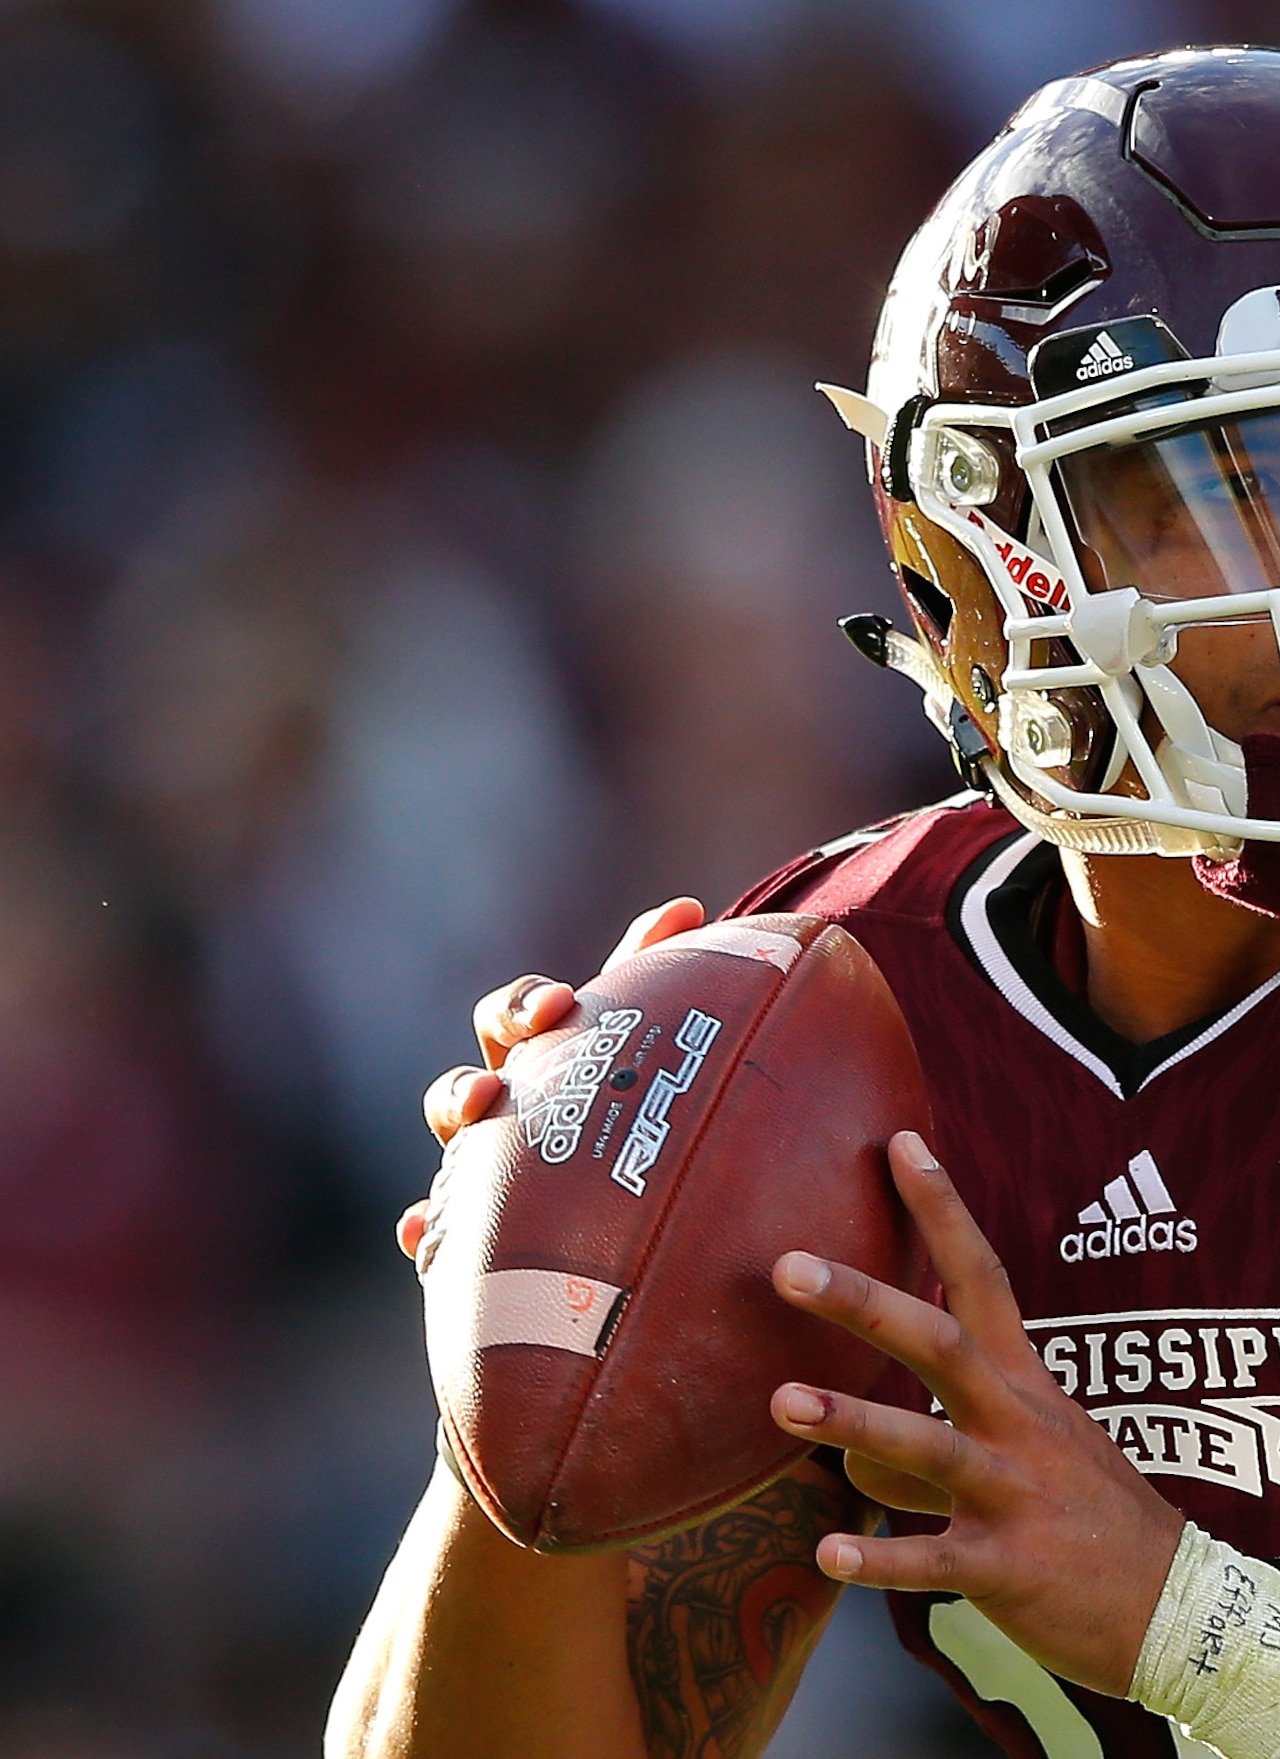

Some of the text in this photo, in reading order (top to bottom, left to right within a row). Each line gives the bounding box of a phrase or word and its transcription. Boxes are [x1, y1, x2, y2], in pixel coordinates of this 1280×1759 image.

[1076, 355, 1134, 381] adidas
[541, 1008, 643, 1164] adidas
[610, 1008, 723, 1198] RIFLE
[1060, 1213, 1198, 1263] adidas
[1102, 1413, 1237, 1478] ATE
